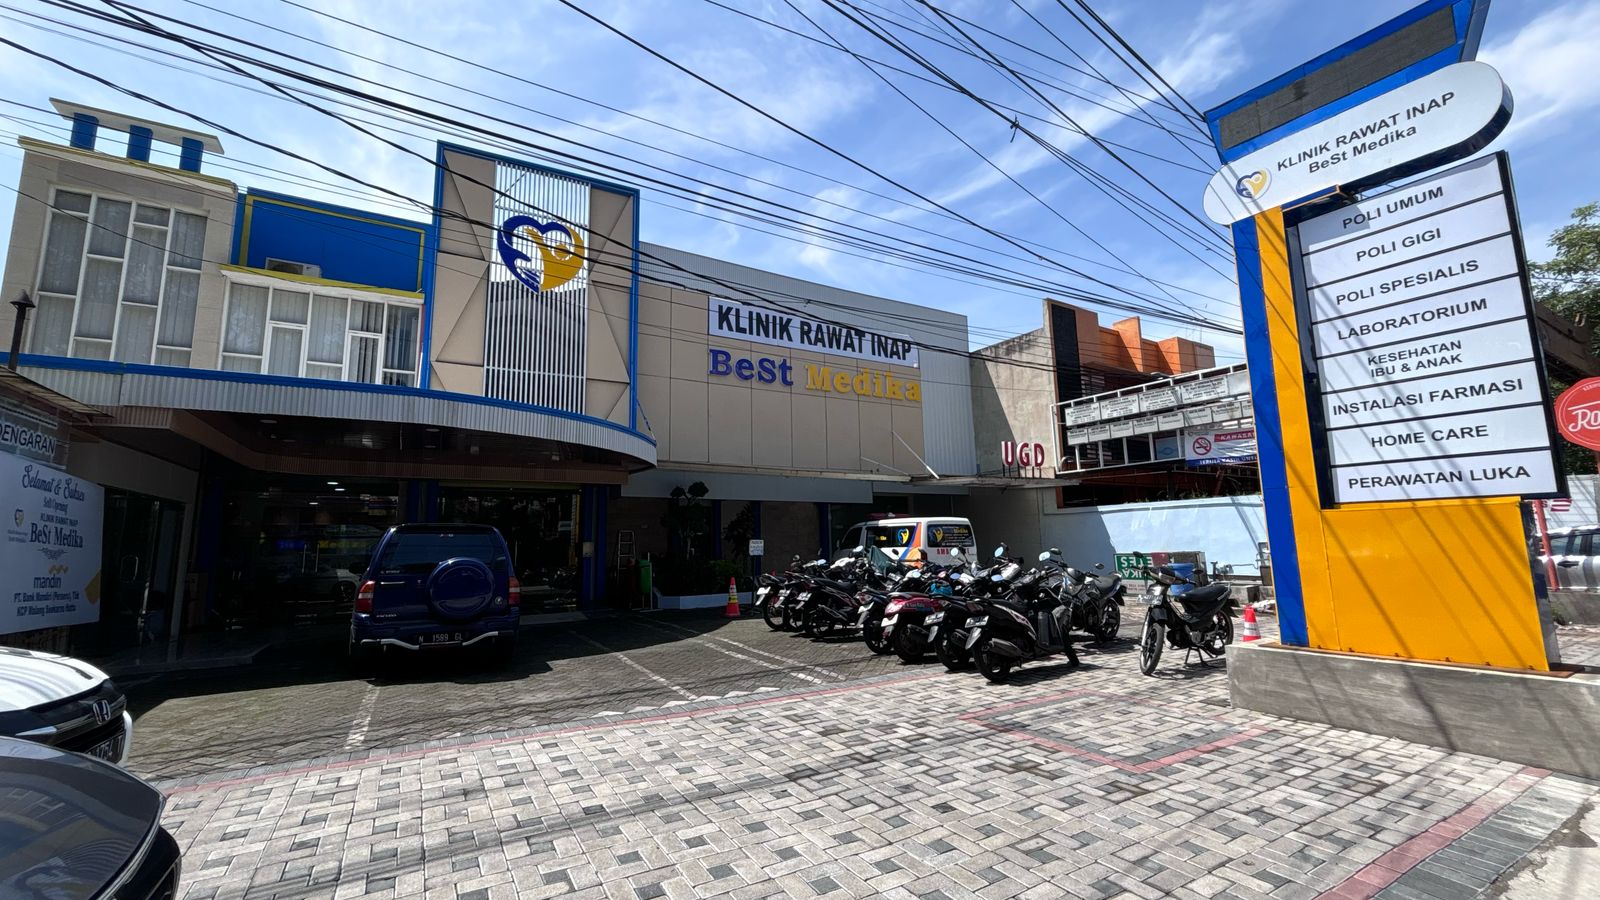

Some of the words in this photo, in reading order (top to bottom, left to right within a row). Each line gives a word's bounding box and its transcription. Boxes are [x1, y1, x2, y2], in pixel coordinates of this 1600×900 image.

[1277, 145, 1331, 171] KLINIK
[1336, 113, 1400, 147] RAWAT
[1406, 91, 1455, 120] INAP
[1309, 151, 1348, 173] BeSt
[1352, 126, 1417, 155] Medika
[1342, 207, 1382, 229] POLI
[1386, 186, 1444, 216] UMUM
[1356, 241, 1396, 262] POLI
[1402, 228, 1441, 254] GIGI
[1336, 286, 1375, 305] POLI
[1379, 259, 1479, 295] SPESIALIS
[718, 304, 793, 342] KLINIK
[800, 320, 865, 354] RAWAT
[871, 335, 912, 361] INAP
[1338, 298, 1488, 341] LABORATORIUM
[1367, 340, 1462, 366] KESEHATAN
[1370, 365, 1395, 378] IBU
[1401, 363, 1411, 373] &
[1415, 353, 1463, 371] ANAK
[709, 348, 793, 386] BeSt
[805, 364, 920, 401] Medika
[1333, 392, 1423, 416] INSTALASI
[1429, 378, 1523, 403] FARMASI
[0, 423, 56, 454] ENGARAN
[1371, 432, 1425, 448] HOME
[1431, 424, 1489, 441] CARE
[1001, 441, 1045, 467] UGD
[22, 464, 55, 493] Selamat
[54, 478, 61, 496] &
[1348, 469, 1463, 490] PERAWATAN
[1469, 465, 1531, 482] LUKA
[30, 522, 52, 544] BeSt
[54, 526, 84, 548] Medika
